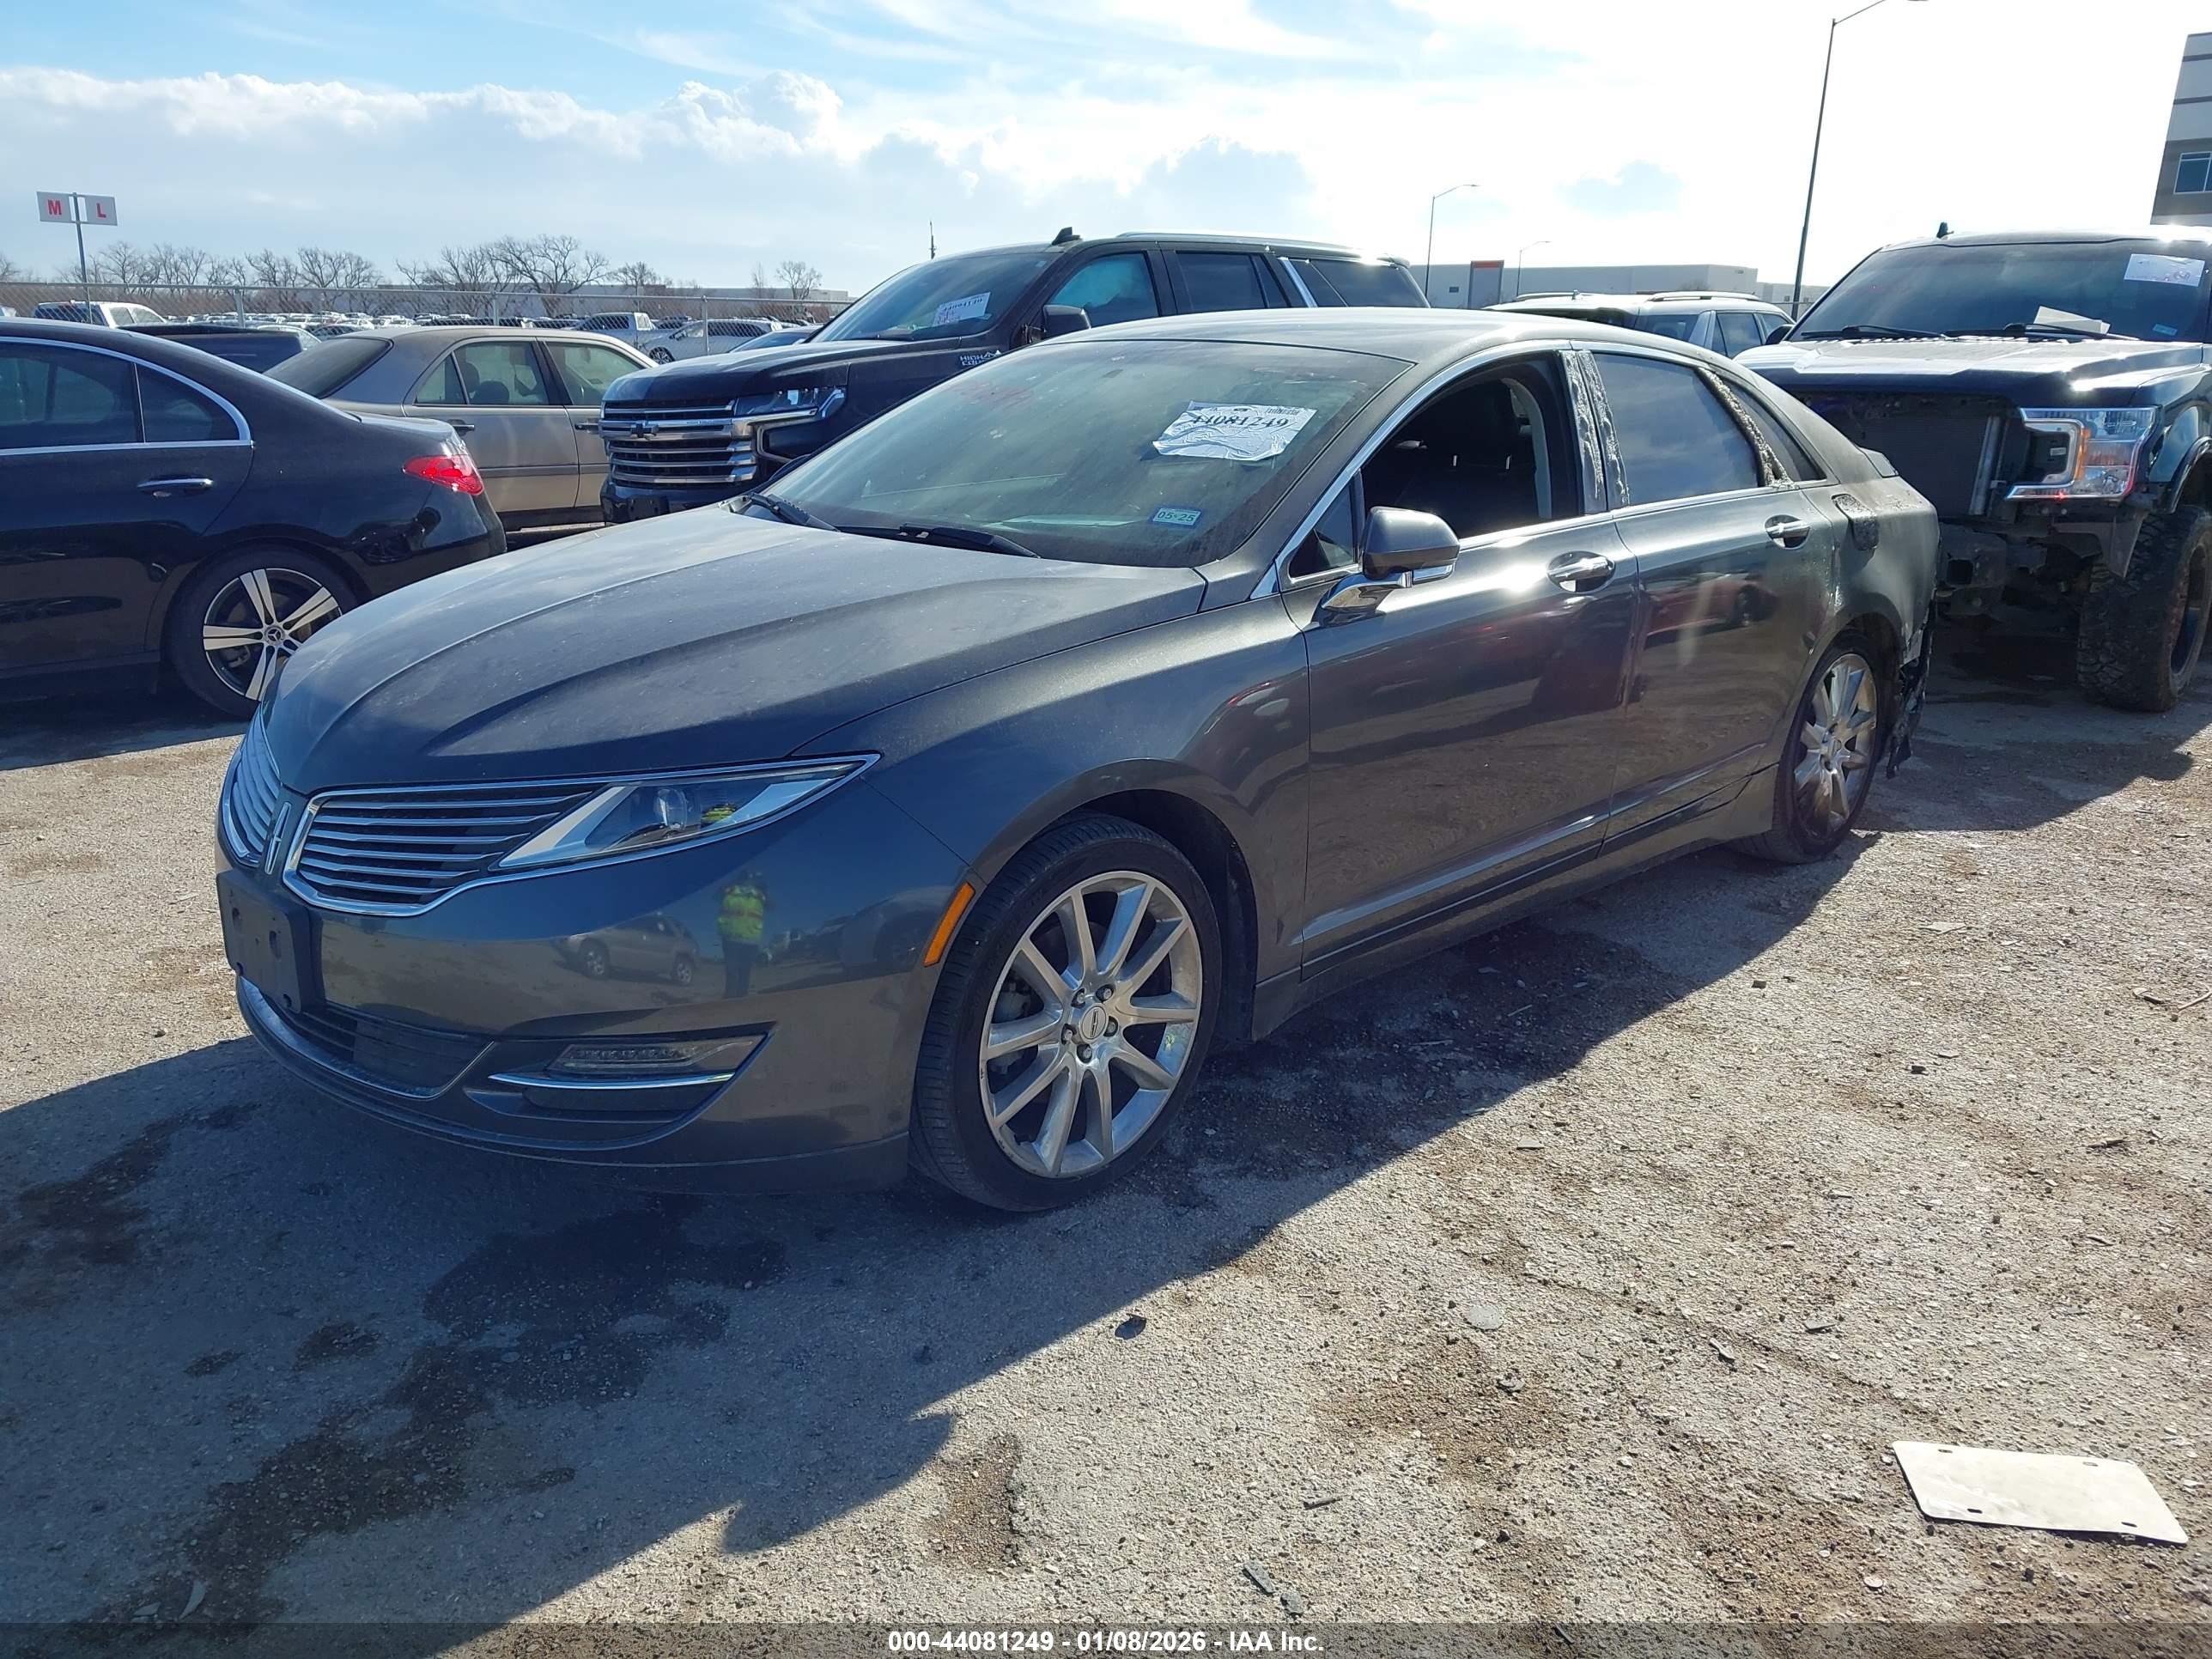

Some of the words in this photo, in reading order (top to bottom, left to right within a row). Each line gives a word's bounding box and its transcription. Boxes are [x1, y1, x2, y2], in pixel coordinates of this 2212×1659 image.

[47, 199, 62, 216] M
[96, 203, 106, 218] L
[1192, 414, 1289, 428] 44081249
